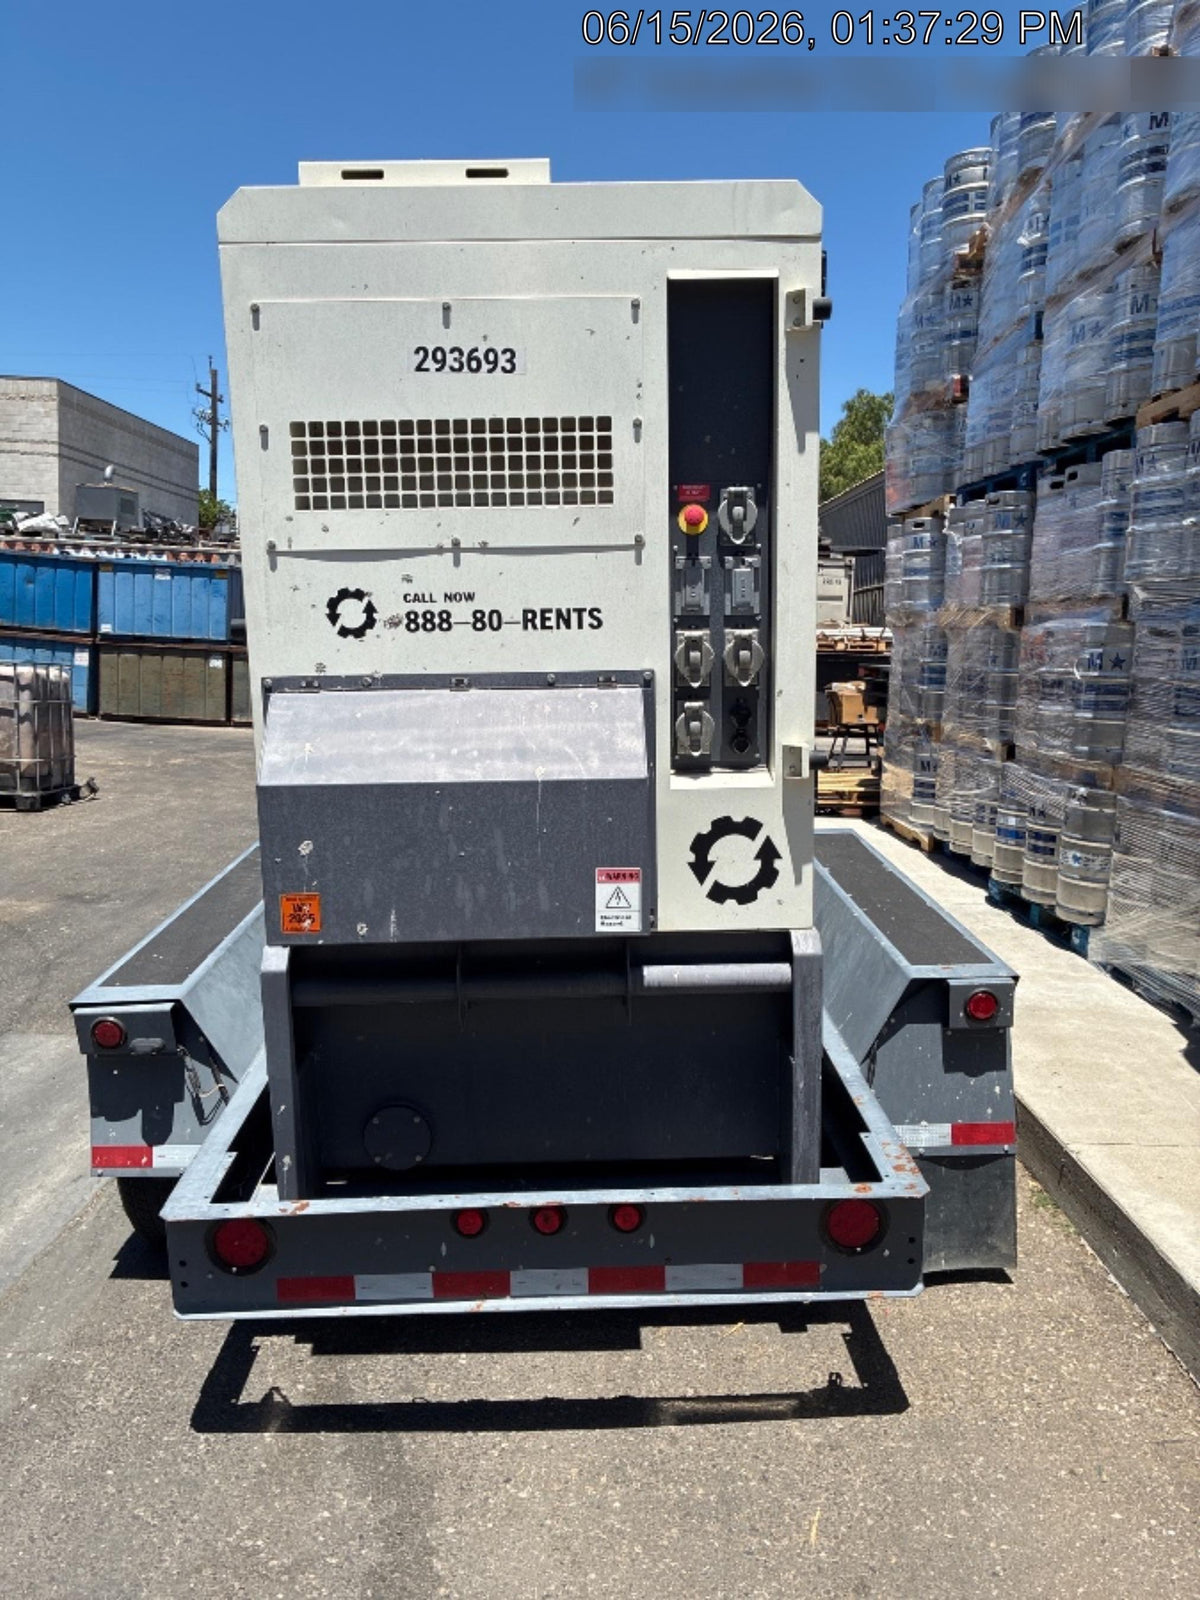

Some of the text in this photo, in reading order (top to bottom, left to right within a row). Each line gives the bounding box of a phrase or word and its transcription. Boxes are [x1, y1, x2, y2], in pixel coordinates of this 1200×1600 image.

[413, 345, 517, 375] 293693
[402, 591, 476, 604] CALL NOW
